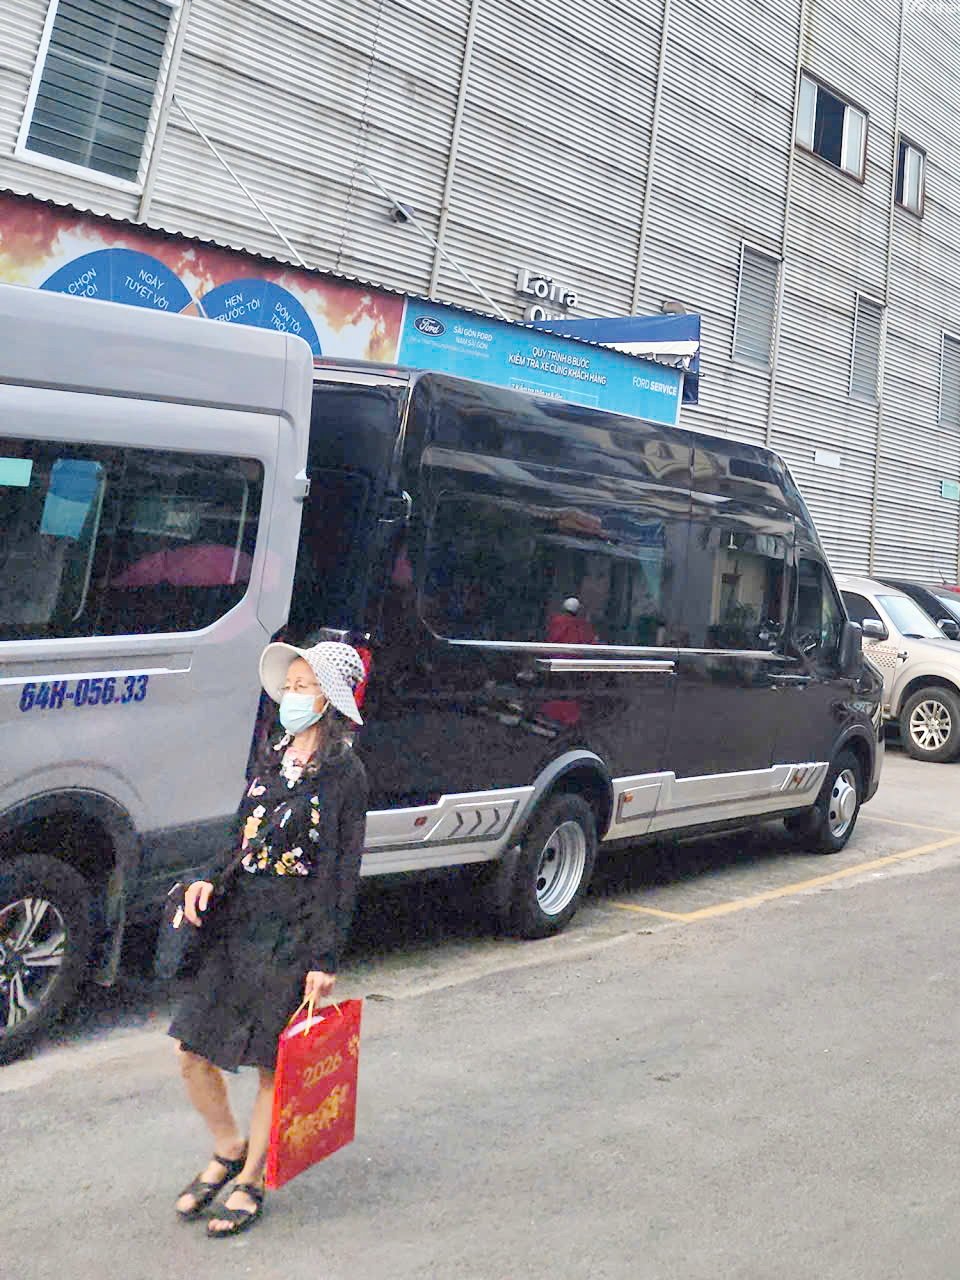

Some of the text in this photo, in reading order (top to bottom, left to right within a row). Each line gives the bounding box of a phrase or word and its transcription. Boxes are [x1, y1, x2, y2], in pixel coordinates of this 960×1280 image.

[68, 268, 97, 293] CHỌN
[246, 298, 260, 312] TÔI
[559, 286, 578, 308] ra
[419, 318, 441, 334] Ford
[476, 331, 493, 341] FORD
[532, 346, 547, 358] QUY
[547, 350, 567, 364] TRÌNH
[567, 355, 573, 365] 8
[508, 351, 607, 385] KIỂM TRA XE CÙNG KHÁCH HÀNG
[632, 376, 678, 396] FORD SERVICE
[19, 675, 149, 712] 64H-056.33
